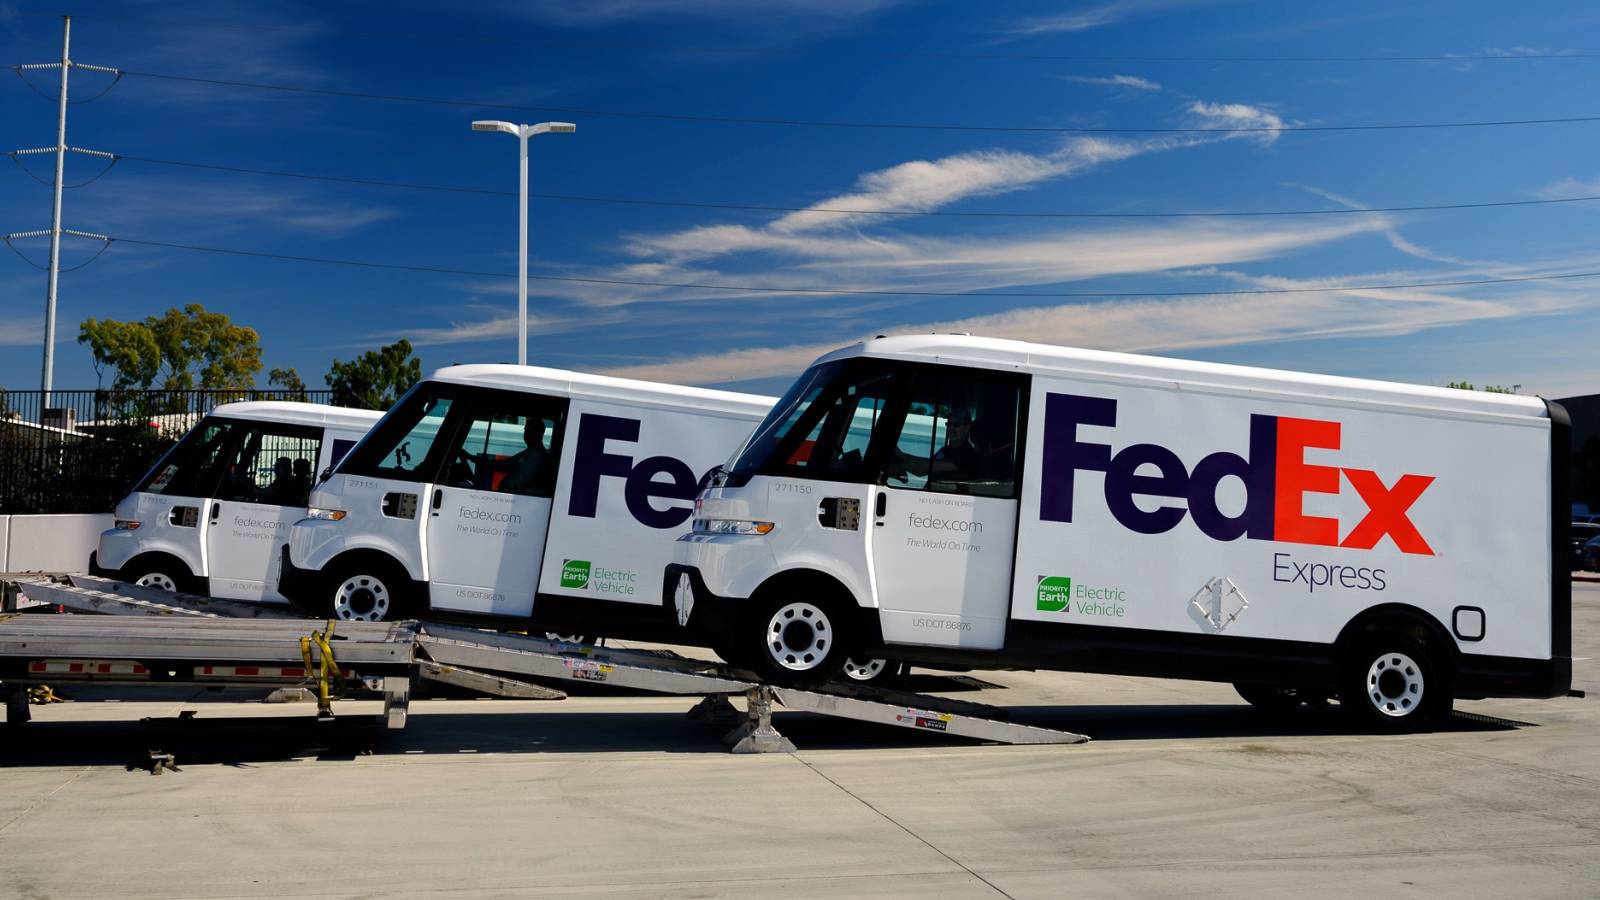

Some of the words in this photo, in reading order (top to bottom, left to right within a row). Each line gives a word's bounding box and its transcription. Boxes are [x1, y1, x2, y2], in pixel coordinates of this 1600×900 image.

[568, 413, 724, 529] Fe
[1040, 392, 1436, 556] FedEx
[775, 483, 812, 494] 271150
[234, 515, 285, 529] fedex.com
[459, 505, 521, 524] fedex.com
[456, 524, 469, 532] The
[908, 512, 983, 533] fedex.com
[907, 537, 922, 547] The
[923, 538, 947, 550] World
[948, 540, 960, 551] On
[961, 542, 981, 552] Time
[563, 571, 588, 582] Earth
[594, 567, 637, 582] Electric
[1273, 552, 1386, 593] Express
[456, 588, 466, 598] US
[594, 580, 634, 595] Vehicle
[1039, 584, 1068, 592] PRIORITY
[1076, 584, 1126, 602] Electric
[1039, 591, 1068, 603] Earth
[1076, 601, 1125, 617] Vehicle
[912, 618, 924, 628] US
[926, 619, 945, 629] DOT
[945, 621, 972, 631] 86876
